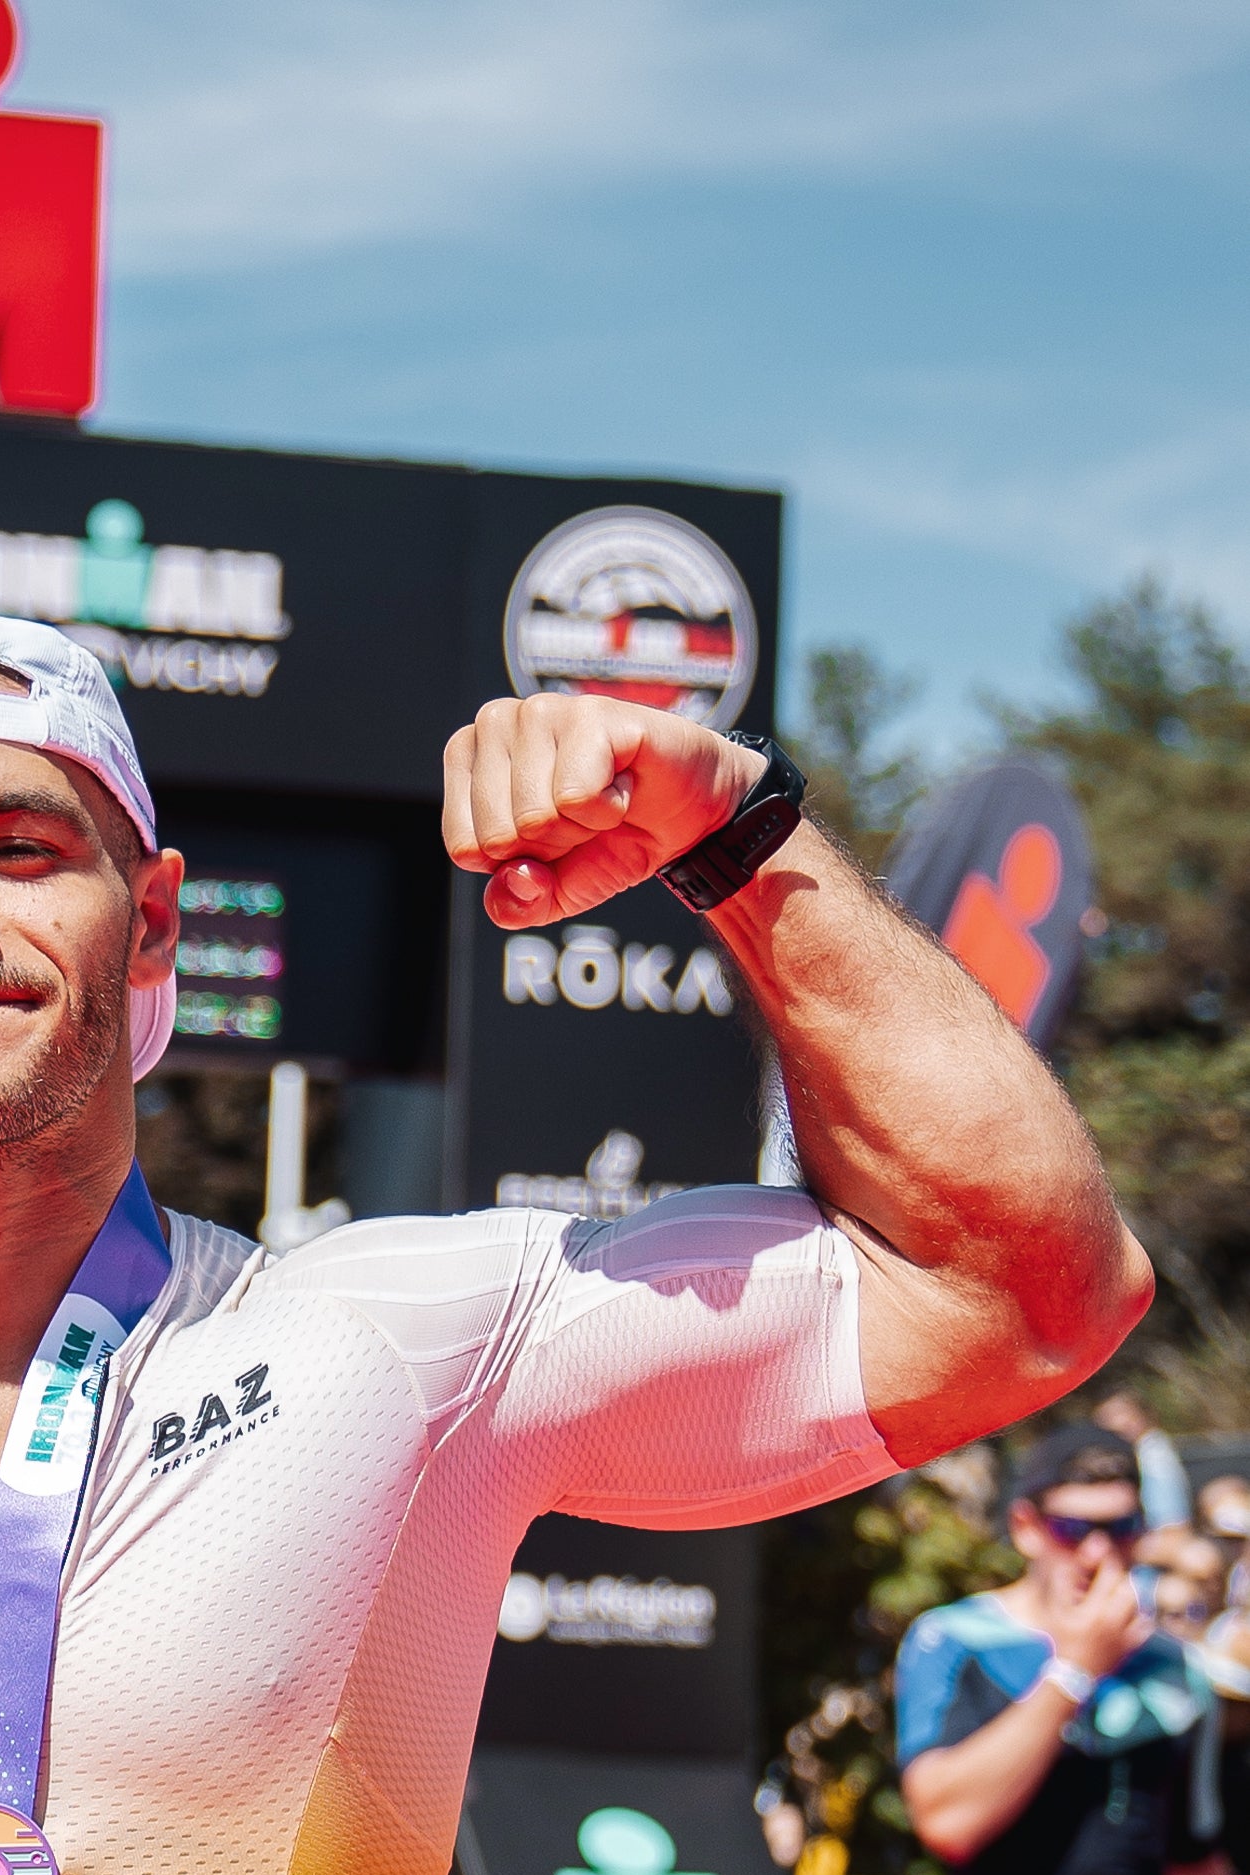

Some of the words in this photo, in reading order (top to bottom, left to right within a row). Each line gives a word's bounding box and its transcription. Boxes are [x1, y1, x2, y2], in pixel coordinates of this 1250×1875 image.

[25, 1322, 97, 1463] IRONMAN
[149, 1363, 272, 1462] BAZ
[151, 1405, 280, 1477] PERFORMANCE
